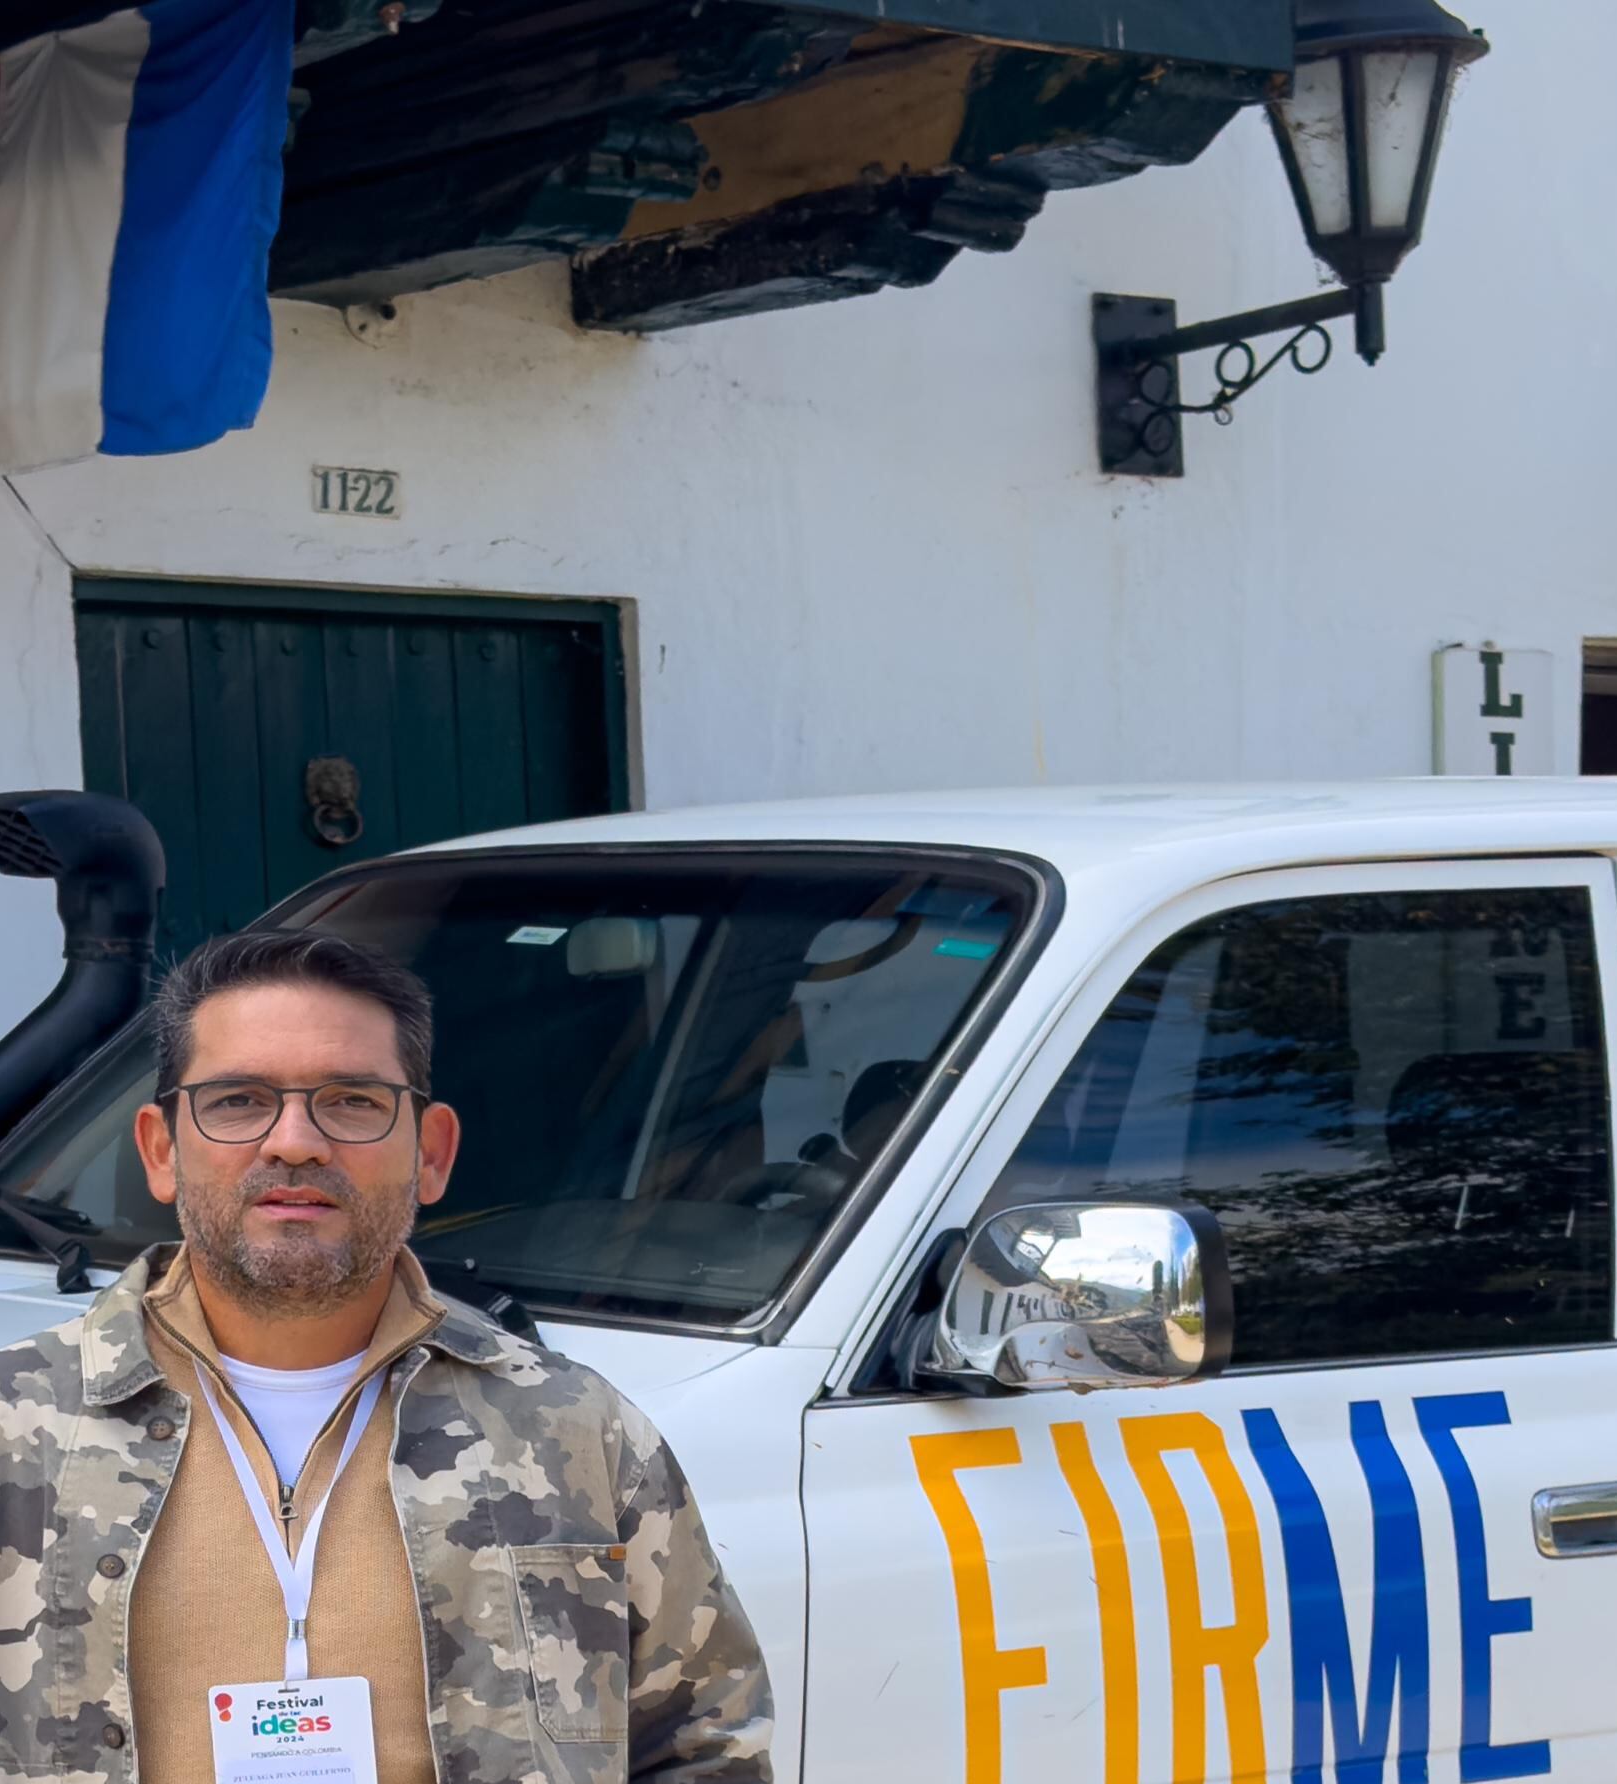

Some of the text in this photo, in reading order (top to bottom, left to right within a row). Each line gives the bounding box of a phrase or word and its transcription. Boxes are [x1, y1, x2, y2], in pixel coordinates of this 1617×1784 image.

[256, 1695, 324, 1711] Festival
[251, 1713, 332, 1736] ideas
[277, 1735, 305, 1744] 2024
[251, 1746, 343, 1759] PENSANDO A COLOMBIA
